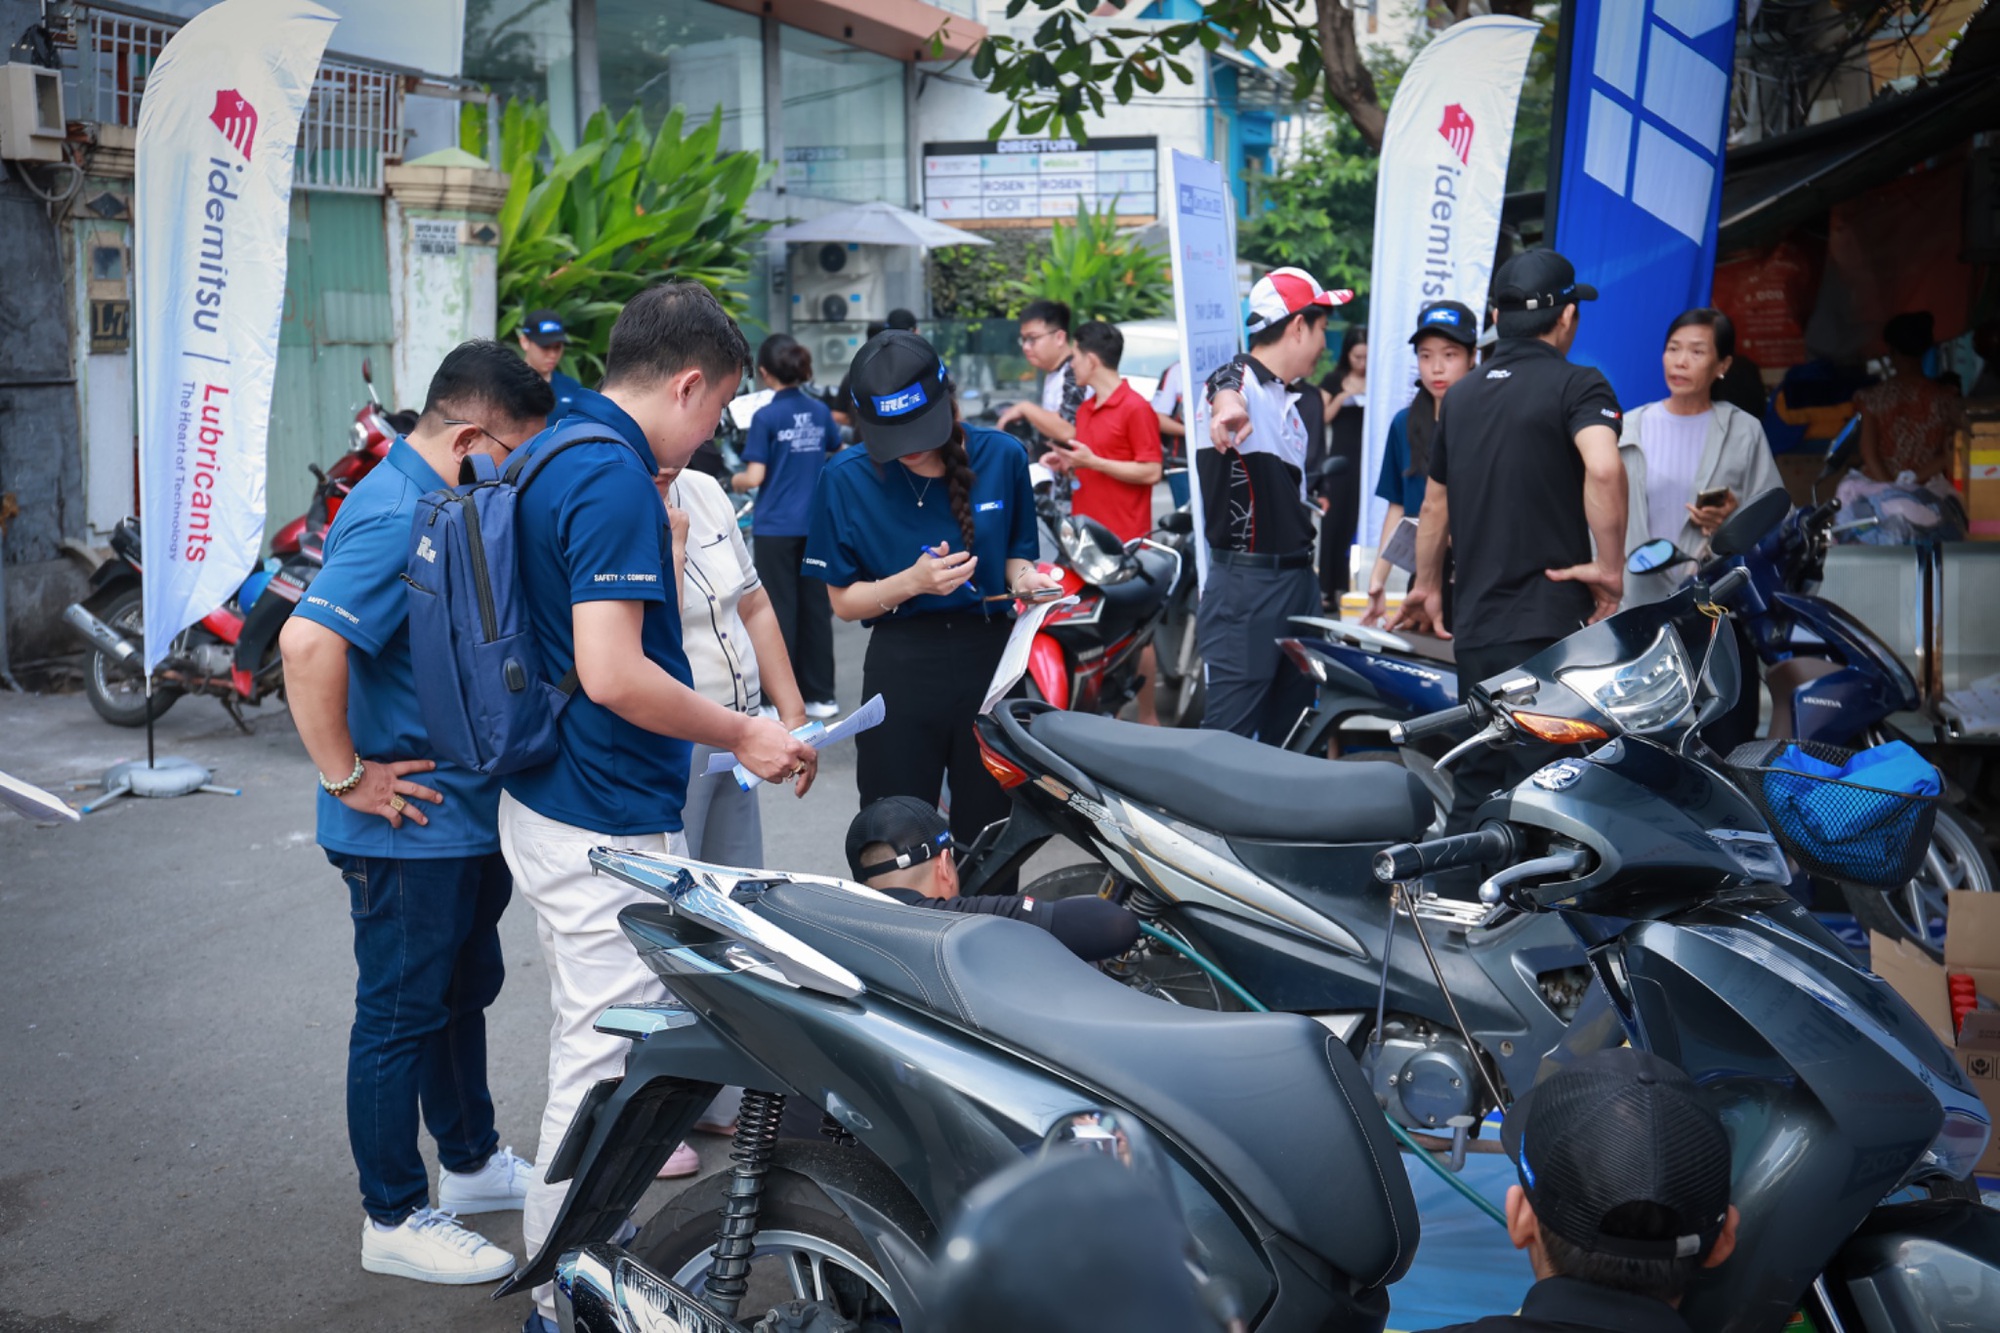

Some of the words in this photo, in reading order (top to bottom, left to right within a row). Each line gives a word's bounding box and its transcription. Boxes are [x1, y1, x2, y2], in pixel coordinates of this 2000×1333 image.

[996, 138, 1078, 153] DIRECTORY
[193, 157, 243, 333] idemitsu
[180, 382, 196, 409] The
[177, 411, 192, 456] Heart
[175, 457, 186, 472] of
[185, 384, 229, 563] Lubricants
[169, 475, 186, 562] Technology
[594, 573, 618, 582] SAFETY
[626, 573, 657, 582] COMFORT
[307, 596, 328, 607] SAFETY
[335, 606, 359, 624] COMFORT
[1803, 696, 1842, 708] HONDA
